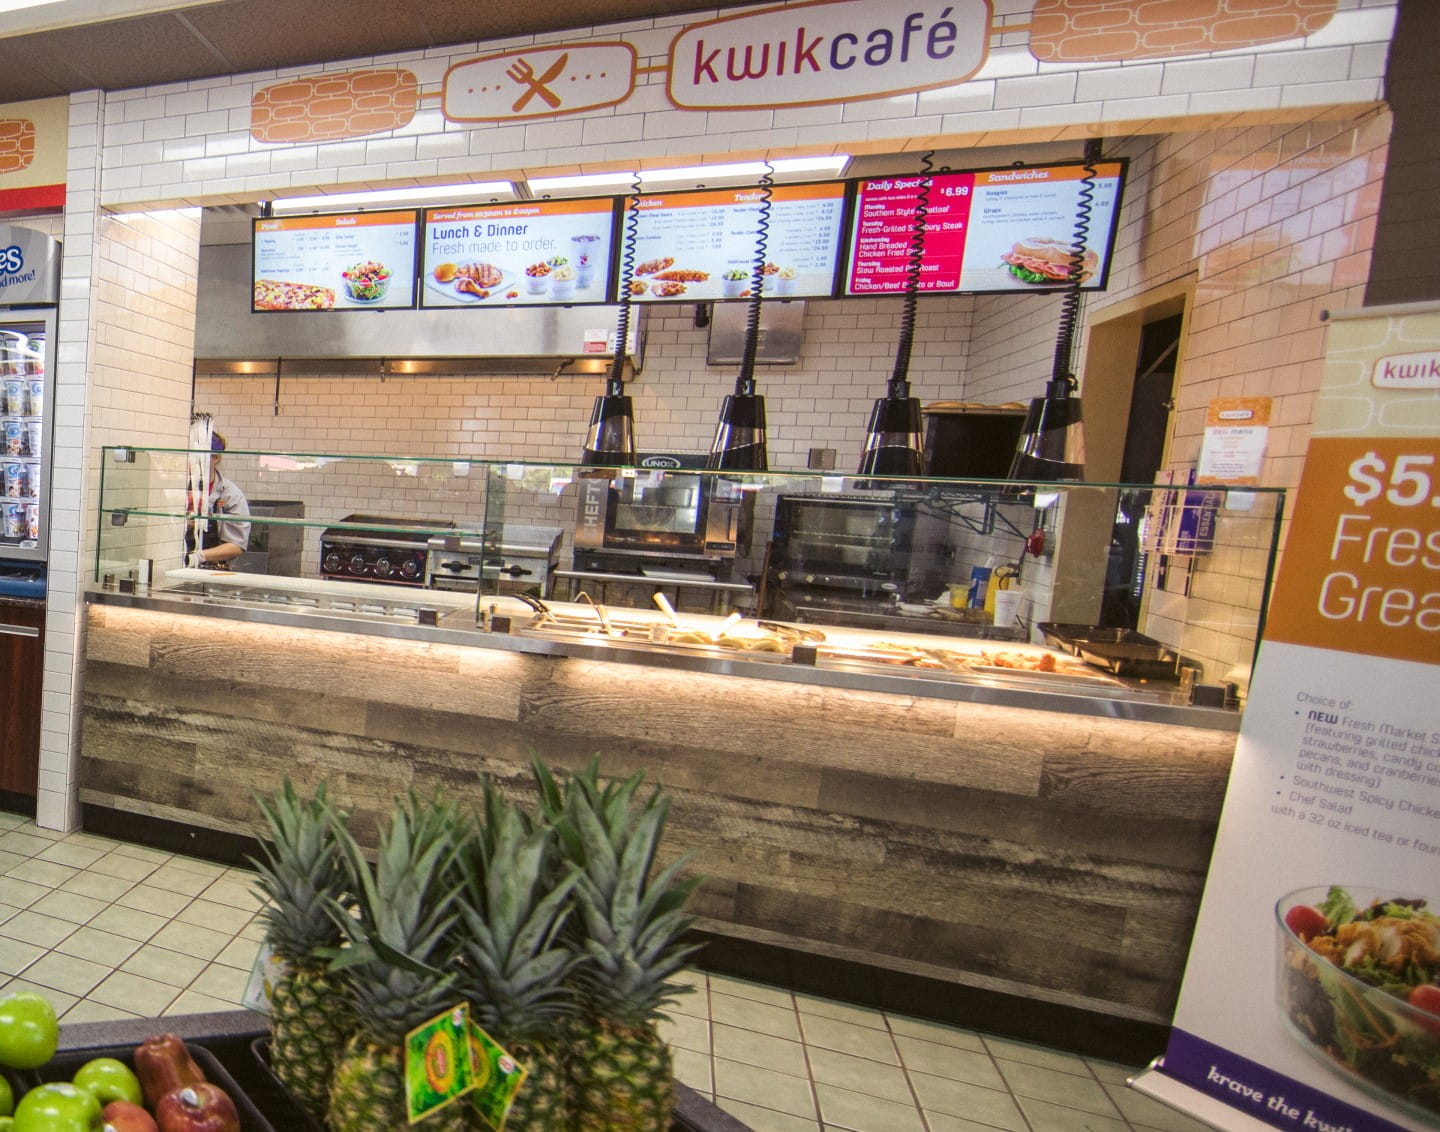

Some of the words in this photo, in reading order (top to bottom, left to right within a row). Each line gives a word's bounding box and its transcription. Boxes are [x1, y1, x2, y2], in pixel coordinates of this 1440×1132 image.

[692, 7, 958, 86] kwikcafé
[867, 181, 893, 191] Daily
[894, 179, 934, 190] Specis
[987, 170, 1049, 183] Sandwiches
[433, 212, 456, 220] Served
[456, 210, 474, 220] from
[863, 209, 895, 218] Southern
[896, 207, 915, 216] Style
[917, 205, 950, 215] atloaf
[433, 226, 469, 240] Lunch
[474, 225, 482, 238] &
[487, 223, 529, 238] Dinner
[907, 223, 941, 233] Sbury
[943, 221, 963, 231] Steak
[432, 241, 465, 256] Fresh
[468, 240, 502, 255] made
[506, 240, 518, 252] to
[522, 237, 558, 252] order.
[858, 250, 886, 258] Chicken
[887, 249, 905, 257] Fried
[906, 248, 926, 256] Stk
[860, 243, 878, 251] Hand
[879, 242, 908, 250] Breaded
[8, 269, 36, 287] more!
[857, 267, 874, 275] Slow
[876, 265, 904, 274] Roasted
[920, 264, 940, 272] Roast
[854, 281, 900, 291] Chicken/Beef
[935, 280, 955, 288] Bowl
[1383, 359, 1440, 380] kwik
[646, 459, 674, 469] UNOX
[1343, 451, 1440, 508] $5.
[583, 478, 602, 538] CHEFT
[1199, 492, 1216, 538] ESSENIAL
[1330, 513, 1440, 571] Fres
[1317, 571, 1440, 632] Grea
[1296, 691, 1336, 708] Choice
[1341, 716, 1376, 732] Fresh
[1379, 722, 1427, 742] Market
[1431, 733, 1440, 745] S
[1365, 734, 1408, 752] grilled
[1301, 735, 1379, 761] strawberries,
[1383, 751, 1423, 772] candy
[1296, 760, 1322, 775] with
[1324, 766, 1382, 789] dressing)
[1298, 748, 1343, 768] pecans,
[1346, 757, 1370, 772] and
[1372, 764, 1440, 787] cranberrie
[1292, 774, 1355, 800] Southwest
[1359, 789, 1394, 810] Spicy
[1288, 790, 1317, 807] Chef
[1318, 797, 1354, 816] Salad
[1270, 804, 1296, 818] with
[1298, 811, 1306, 821] a
[1309, 812, 1326, 826] 32
[1327, 819, 1342, 830] oz
[1344, 822, 1371, 838] iced
[1372, 828, 1394, 843] tea
[1396, 836, 1412, 847] or
[1207, 1065, 1264, 1103] krave
[1267, 1096, 1301, 1120] the
[1303, 1109, 1354, 1132] kwi
